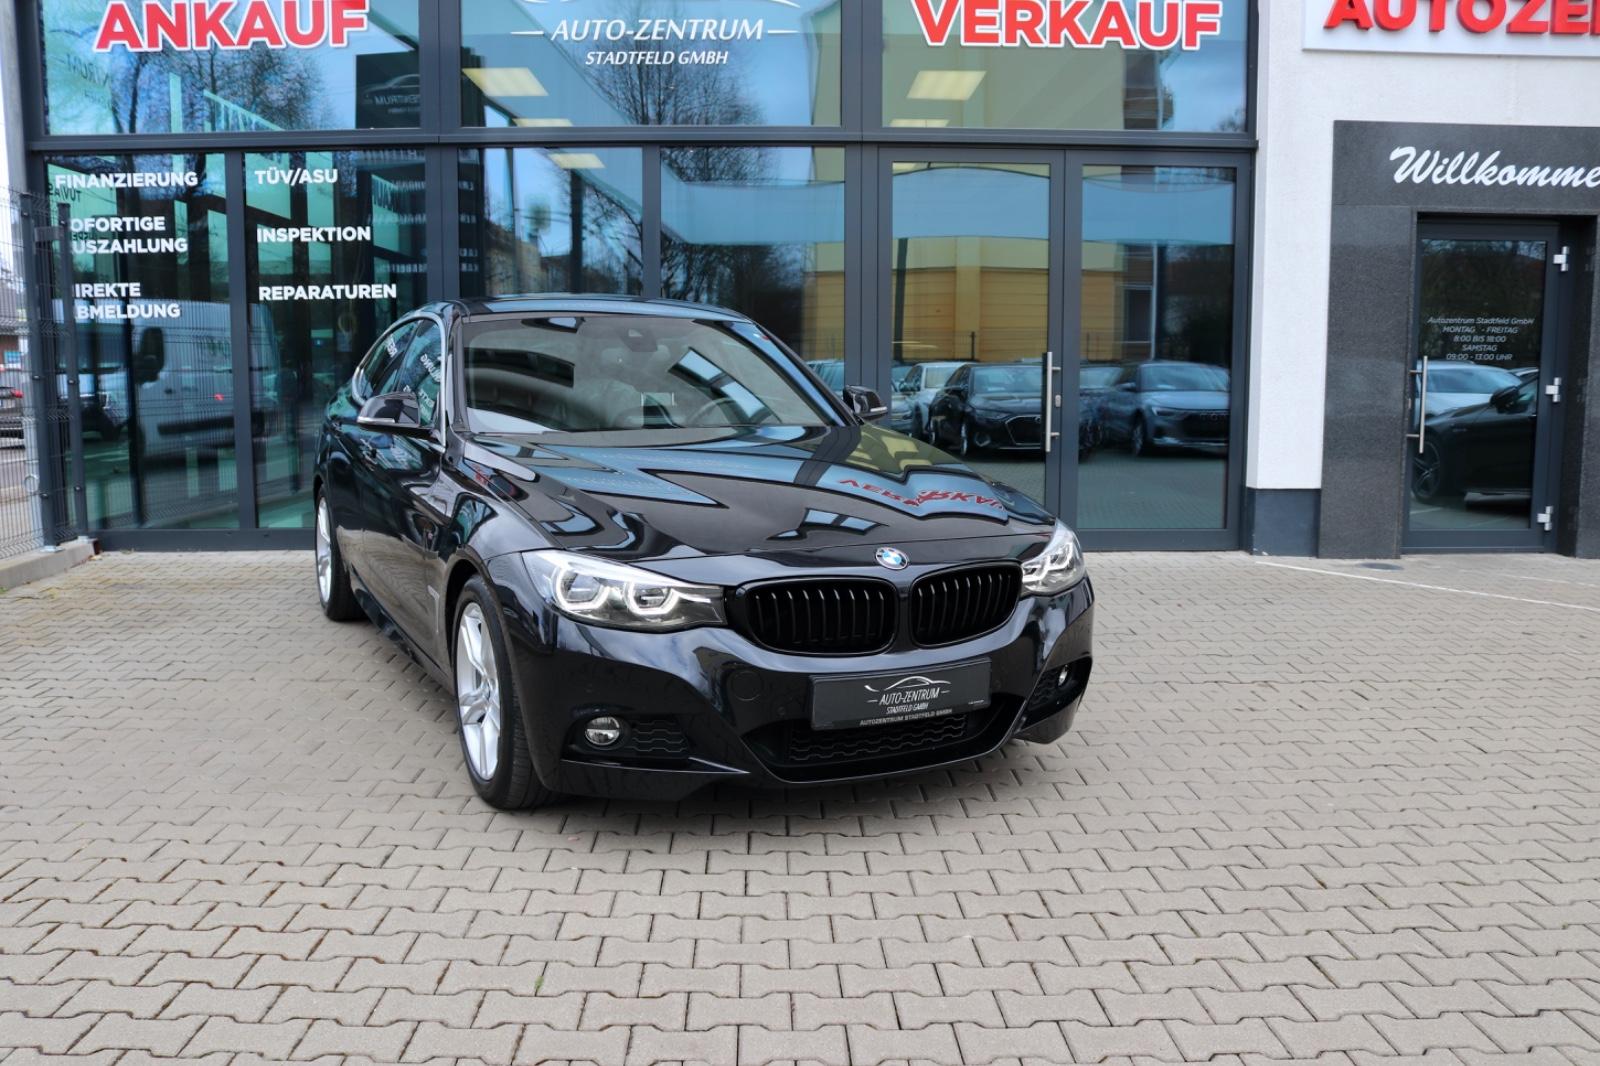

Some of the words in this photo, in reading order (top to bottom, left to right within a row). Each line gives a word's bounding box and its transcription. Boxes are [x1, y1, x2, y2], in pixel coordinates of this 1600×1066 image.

[94, 0, 369, 52] ANKAUF
[910, 0, 1223, 50] VERKAUF
[1322, 0, 1600, 36] AUTOZE
[550, 19, 764, 41] AUTO-ZENTRUM
[585, 51, 675, 65] STADTFELD
[678, 51, 728, 65] GMBH
[55, 171, 198, 189] FINANZIERUNG
[254, 167, 338, 186] TÜV/ASU
[69, 216, 166, 233] OFORTIGE
[256, 226, 371, 243] INSPEKTION
[71, 237, 188, 255] USZAHLUNG
[72, 282, 141, 298] IREKTE
[258, 283, 397, 301] REPARATUREN
[74, 303, 181, 320] BMELDUNG
[1486, 326, 1519, 334] FREITAG
[1462, 344, 1498, 352] SAMSTAG
[879, 687, 940, 706] AUTO-ZENTRUM
